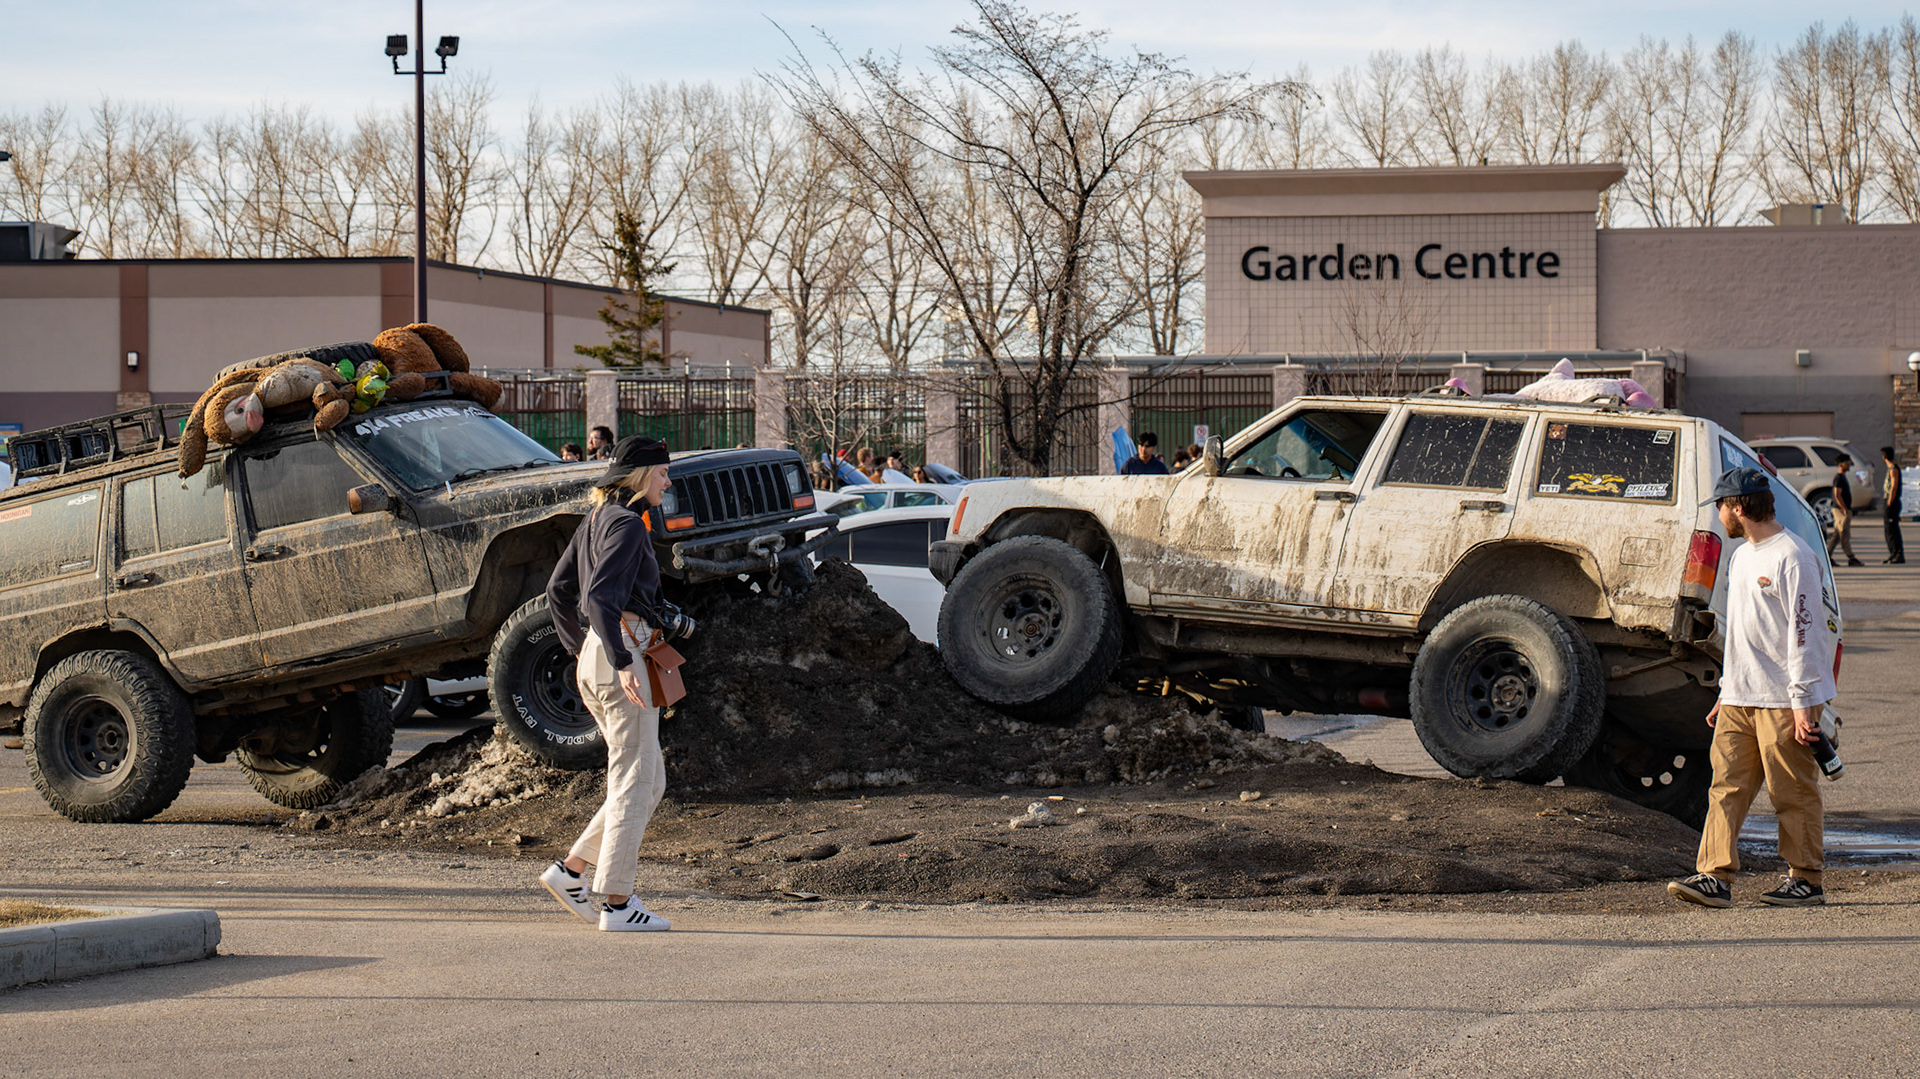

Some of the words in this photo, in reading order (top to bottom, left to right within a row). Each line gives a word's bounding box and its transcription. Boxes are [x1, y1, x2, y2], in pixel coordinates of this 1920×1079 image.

[1241, 243, 1400, 281] Garden
[1414, 243, 1560, 279] Centre
[355, 419, 389, 437] 4X4
[387, 407, 460, 428] FREAKS
[1540, 485, 1559, 493] YETI
[1627, 483, 1668, 493] DYSLEXICS
[527, 626, 557, 645] WIL
[512, 694, 537, 728] RVT
